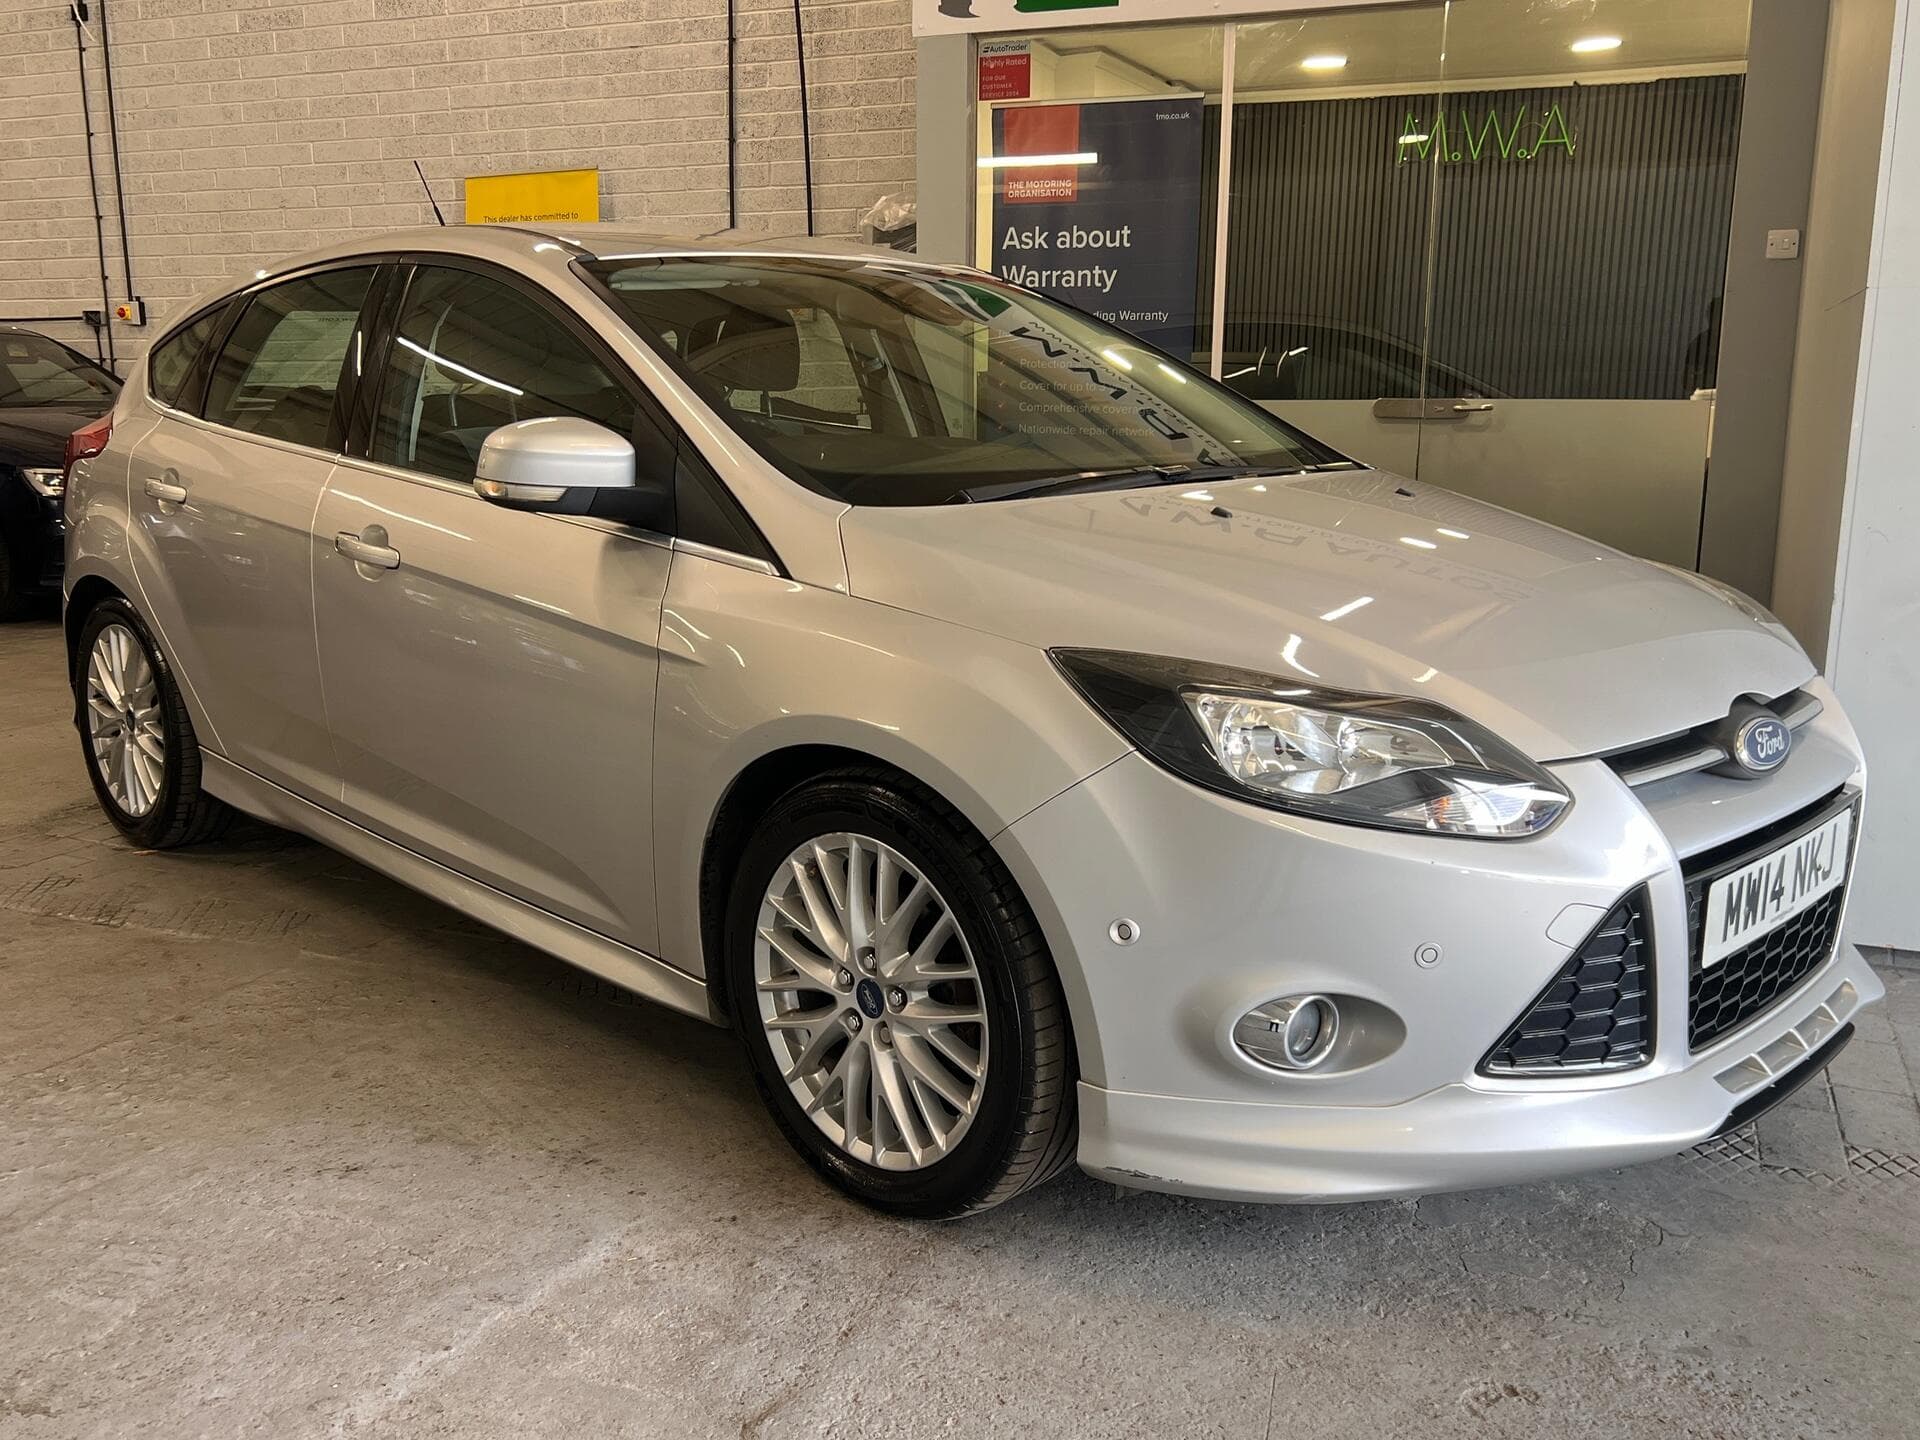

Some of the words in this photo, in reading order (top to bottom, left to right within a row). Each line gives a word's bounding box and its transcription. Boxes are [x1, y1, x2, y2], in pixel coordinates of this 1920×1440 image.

[990, 43, 1028, 53] AutoTrader
[1006, 57, 1027, 66] Rated
[1155, 112, 1190, 121] tmo.co.uk
[1398, 103, 1574, 165] M.W.A
[1008, 181, 1024, 190] THE
[1025, 179, 1072, 189] MOTORING
[1008, 189, 1072, 198] ORGANISATION
[483, 215, 498, 224] This
[499, 215, 519, 223] dealer
[520, 214, 533, 222] has
[534, 212, 570, 222] committed
[571, 211, 579, 220] to
[1002, 226, 1049, 250] Ask
[1056, 225, 1131, 249] about
[1002, 265, 1118, 293] Warranty
[1119, 310, 1169, 324] Warranty
[1020, 358, 1073, 369] Protection
[1019, 381, 1050, 391] Cover
[1053, 380, 1068, 391] for
[1070, 382, 1083, 393] up
[1086, 382, 1096, 391] to
[1018, 401, 1100, 415] Comprehensive
[1018, 423, 1078, 436] Nationwide
[1079, 425, 1108, 437] repair
[1112, 426, 1155, 437] network
[1755, 724, 1786, 759] Ford
[1722, 853, 1786, 944] MW14
[1791, 822, 1838, 904] NKJ
